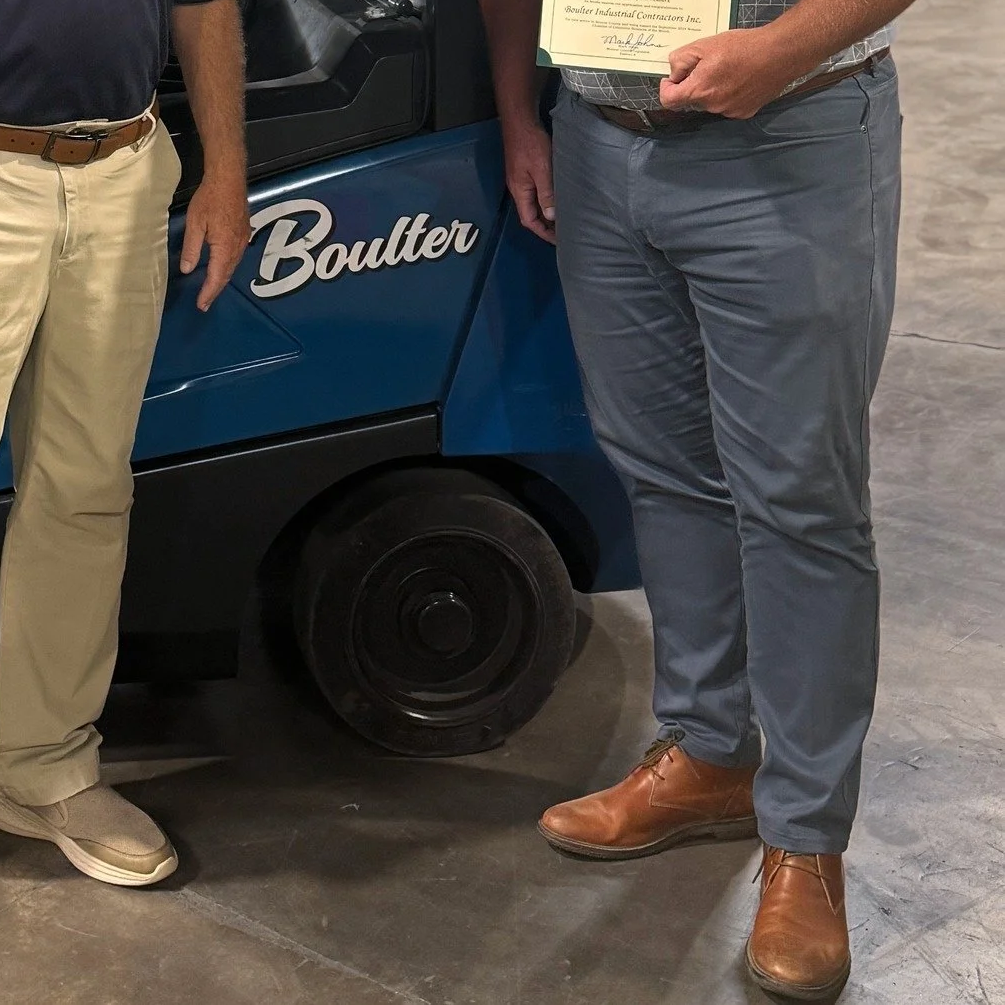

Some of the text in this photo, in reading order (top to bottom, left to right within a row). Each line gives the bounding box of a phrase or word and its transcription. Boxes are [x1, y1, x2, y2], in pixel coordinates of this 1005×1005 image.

[564, 5, 593, 15] Boulter
[595, 7, 635, 19] Industrial
[637, 11, 684, 22] Contractors
[686, 15, 702, 24] Inc.
[249, 198, 480, 299] Boulter
